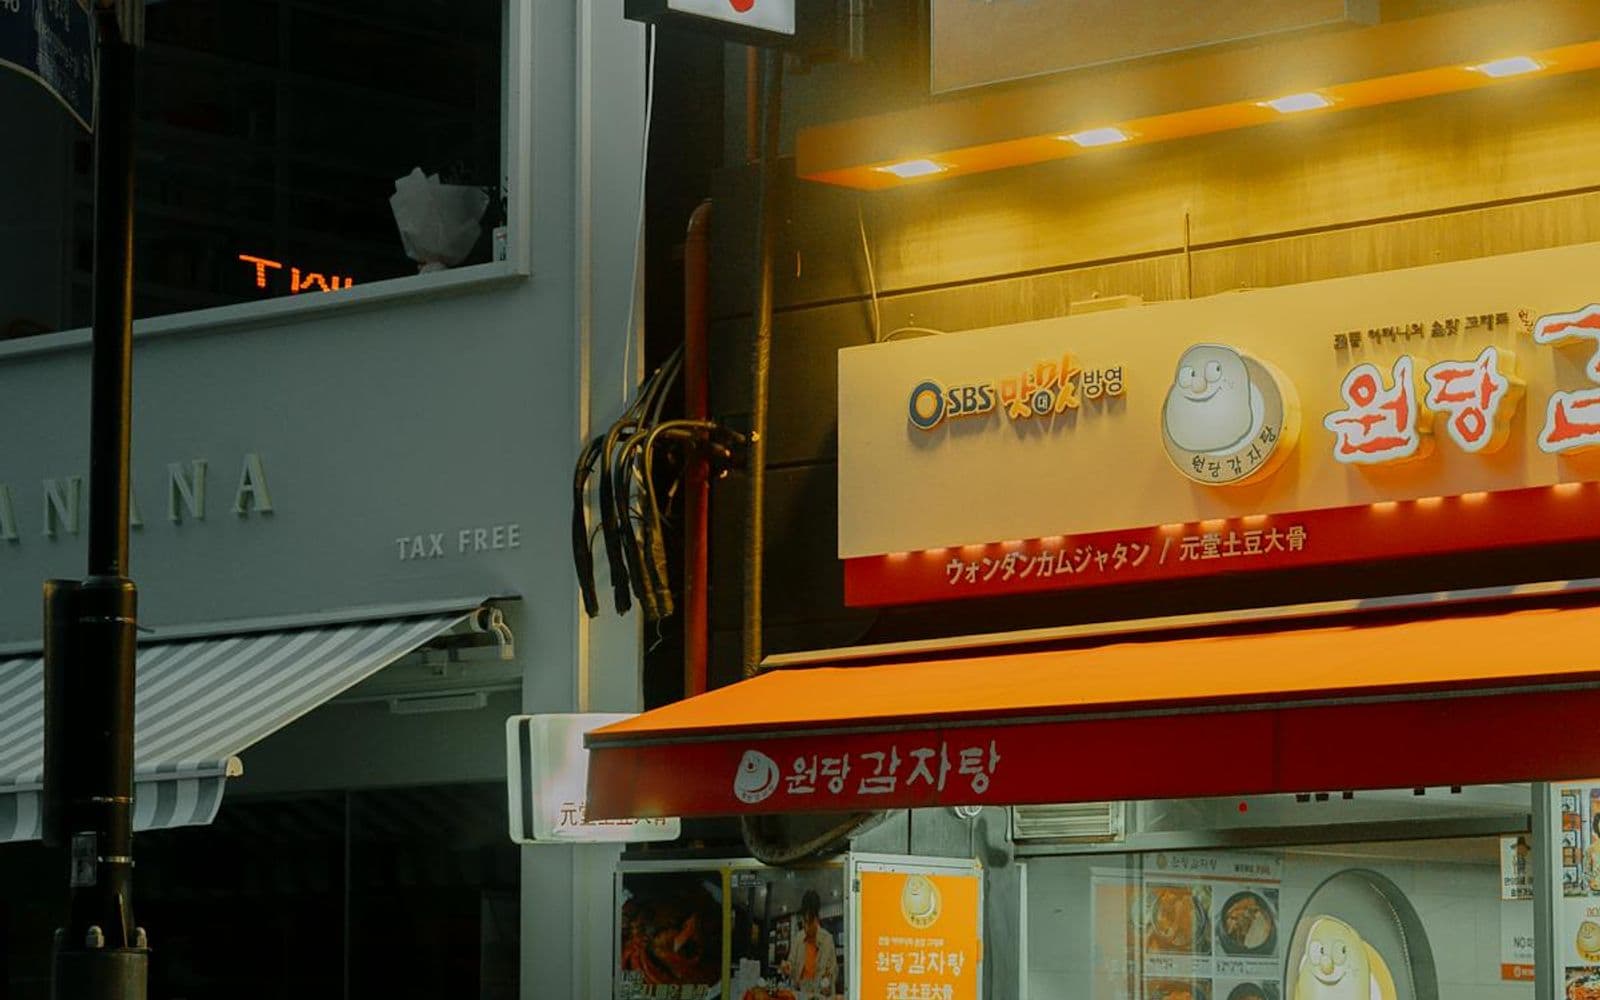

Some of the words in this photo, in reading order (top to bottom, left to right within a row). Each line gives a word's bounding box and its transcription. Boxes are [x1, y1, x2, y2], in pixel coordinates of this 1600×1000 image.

[948, 384, 994, 414] SBS
[1083, 366, 1123, 398] 방영
[1325, 347, 1509, 462] 원당
[396, 533, 444, 560] TAX
[459, 524, 520, 553] FREE
[1179, 525, 1307, 563] 元堂土豆大骨
[785, 754, 850, 795] 원당
[857, 740, 1001, 795] 감자탕
